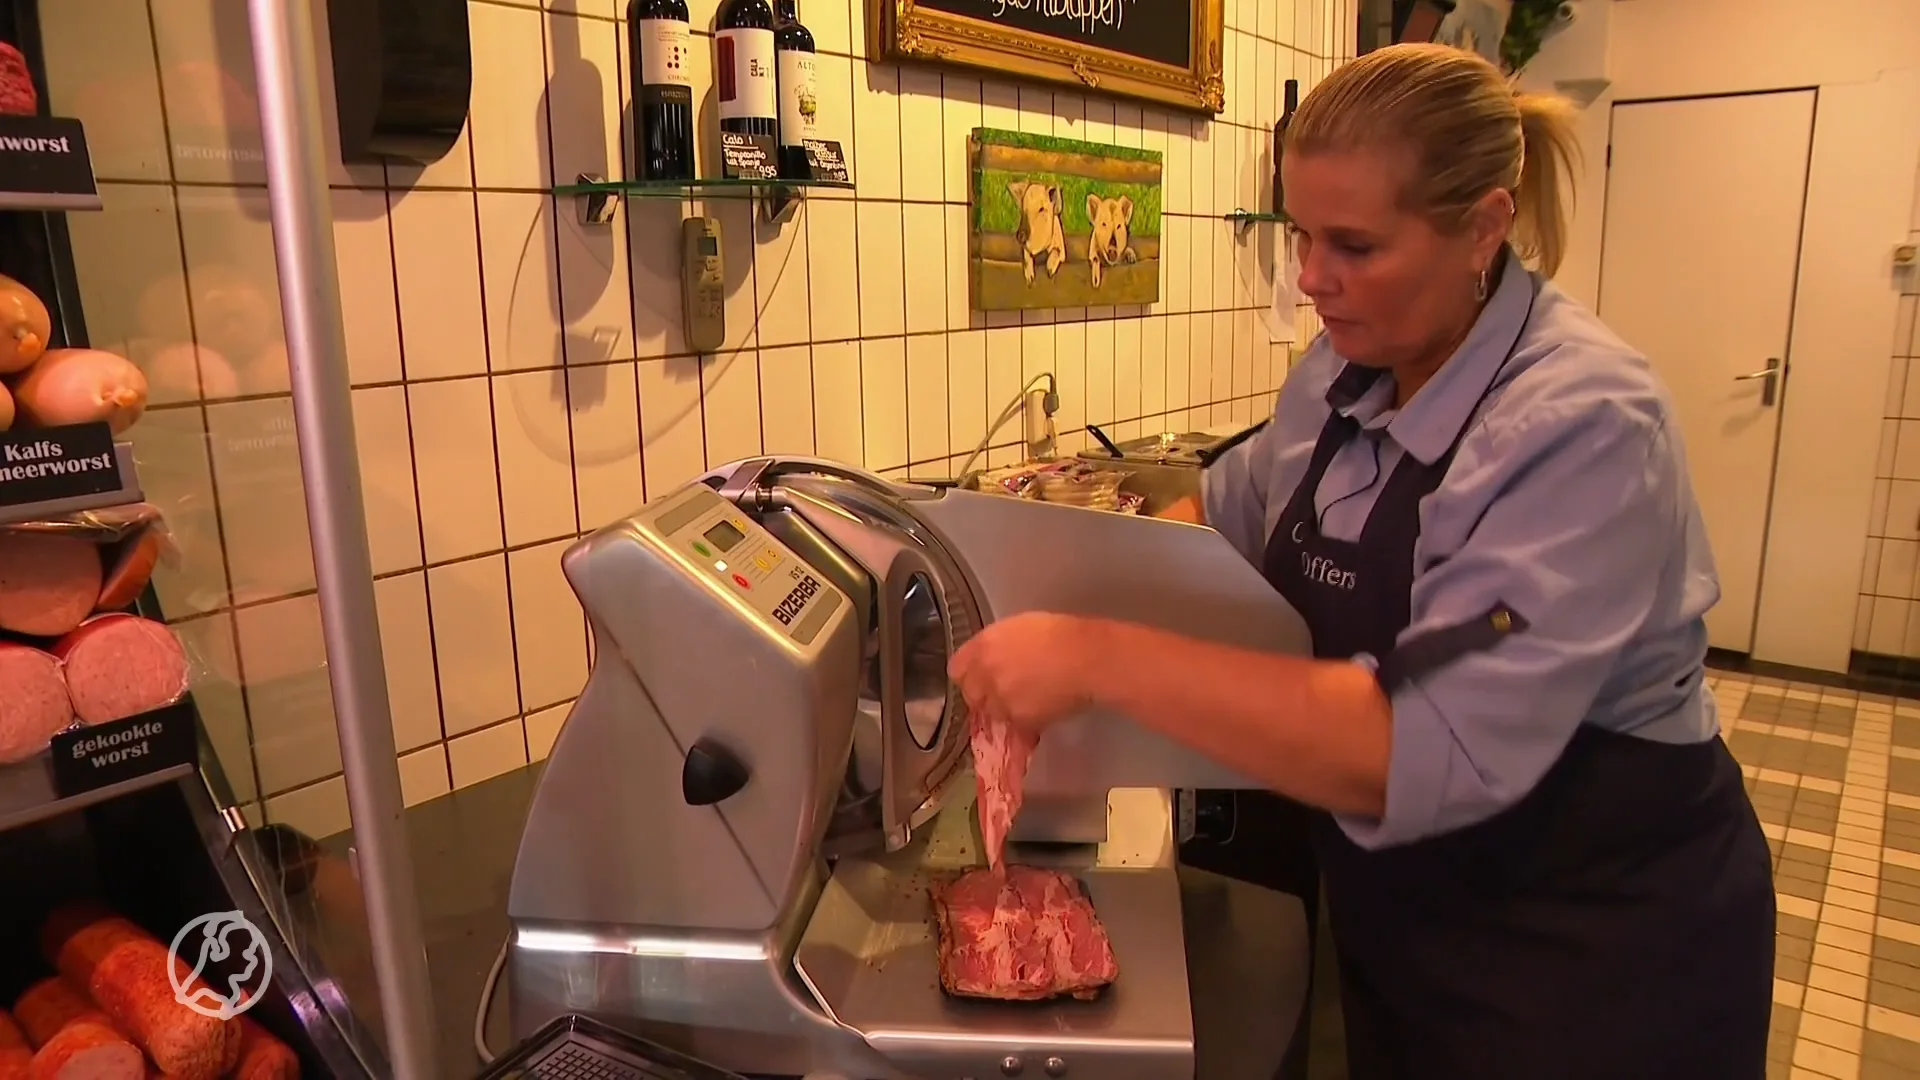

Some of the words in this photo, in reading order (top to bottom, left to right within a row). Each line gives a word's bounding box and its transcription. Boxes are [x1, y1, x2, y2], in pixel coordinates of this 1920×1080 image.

[4, 441, 63, 462] Kalfs
[1301, 551, 1357, 590] Offers
[772, 575, 821, 626] BIZERBA
[72, 722, 163, 759] gekookte
[91, 741, 150, 769] worst
